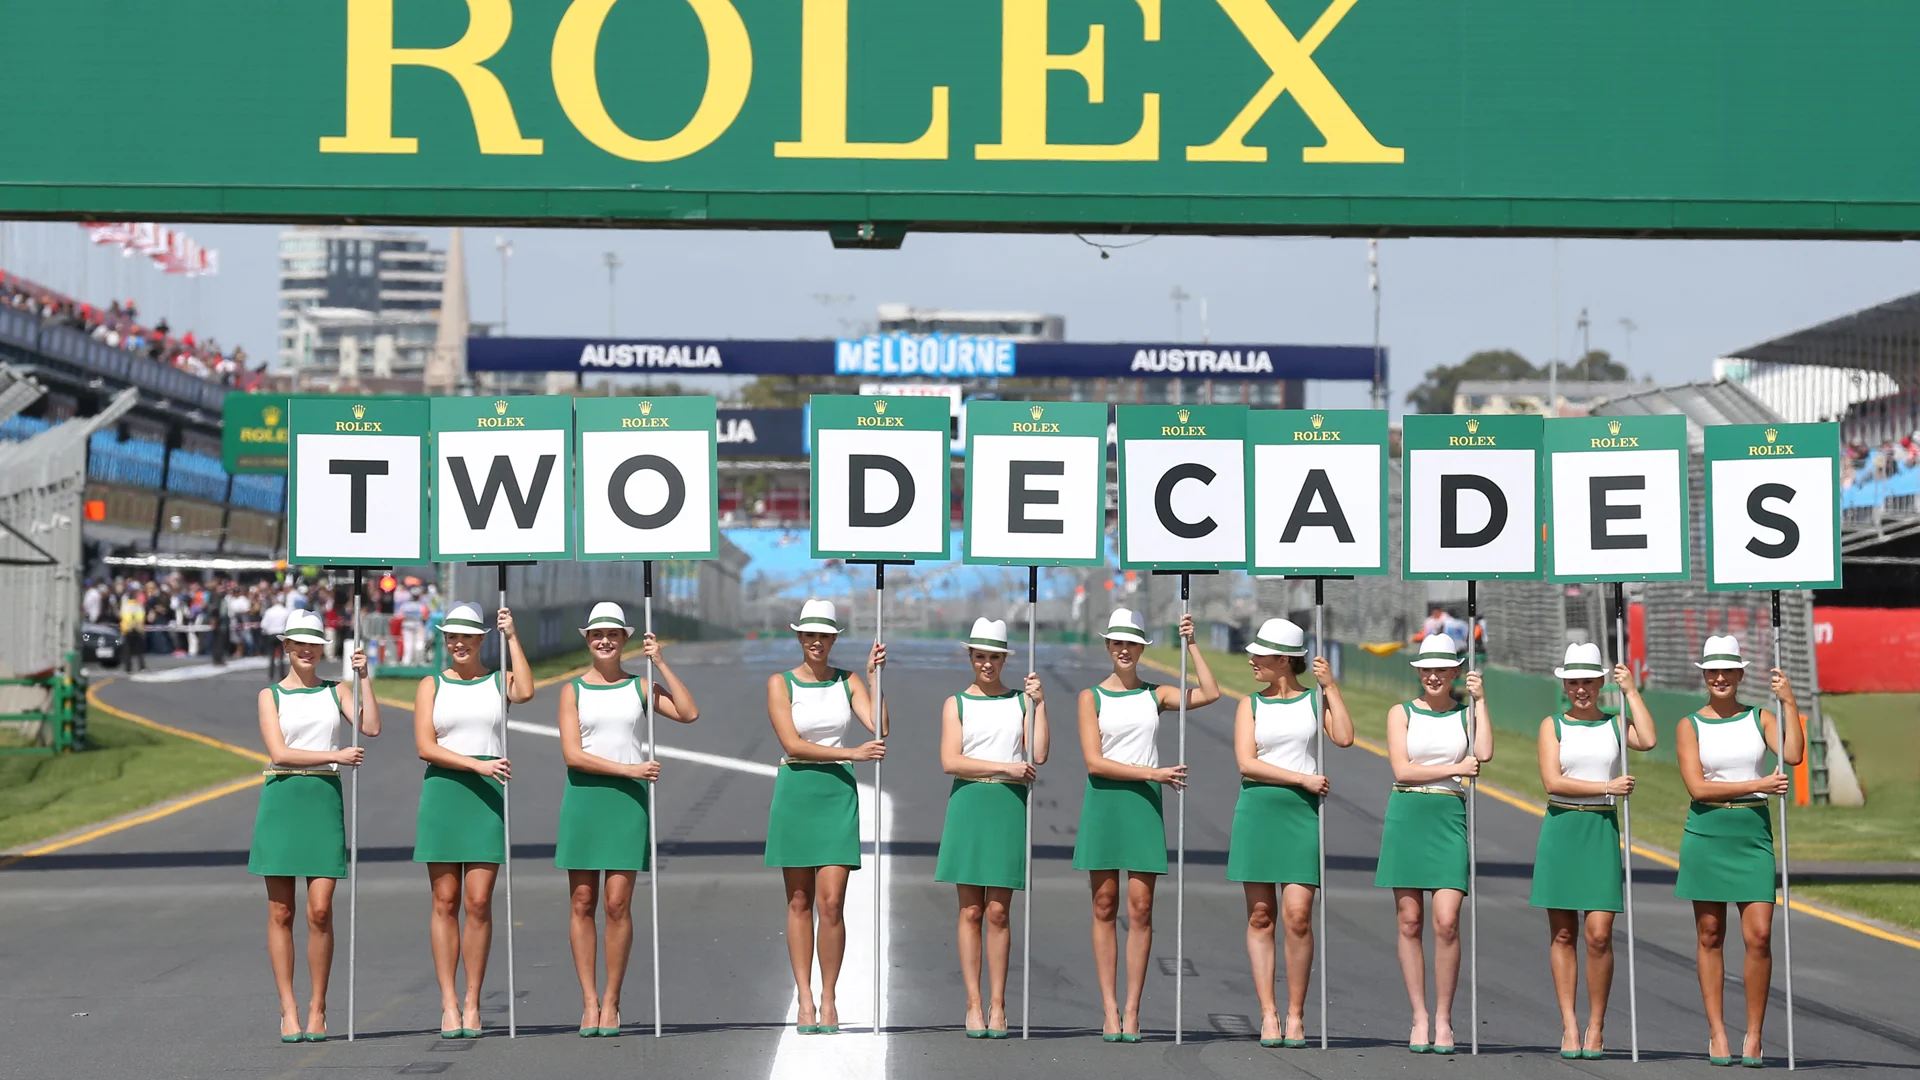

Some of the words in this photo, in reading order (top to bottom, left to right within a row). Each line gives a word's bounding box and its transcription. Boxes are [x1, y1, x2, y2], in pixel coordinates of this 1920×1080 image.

[319, 0, 1405, 163] ROLEX
[579, 344, 722, 368] AUSTRALIA
[837, 335, 1014, 374] MELBOURNE
[1130, 350, 1274, 373] AUSTRALIA
[335, 420, 382, 432] ROLEX
[477, 416, 524, 427] ROLEX
[621, 417, 670, 428] ROLEX
[857, 416, 904, 427] ROLEX
[1012, 421, 1060, 433] ROLEX
[1161, 425, 1207, 436] ROLEX
[240, 427, 288, 443] ROLE
[1293, 430, 1341, 442] ROLEX
[1448, 435, 1496, 446] ROLEX
[1590, 436, 1639, 448] ROLEX
[1749, 444, 1794, 456] ROLEX
[329, 460, 388, 533] T
[447, 455, 556, 529] W
[608, 455, 685, 529] O
[849, 455, 915, 527] D
[1008, 461, 1064, 533] E
[1155, 463, 1217, 538] C
[1280, 470, 1355, 542] A
[1441, 475, 1507, 548] D
[1590, 476, 1647, 549] E
[1746, 483, 1799, 558] S
